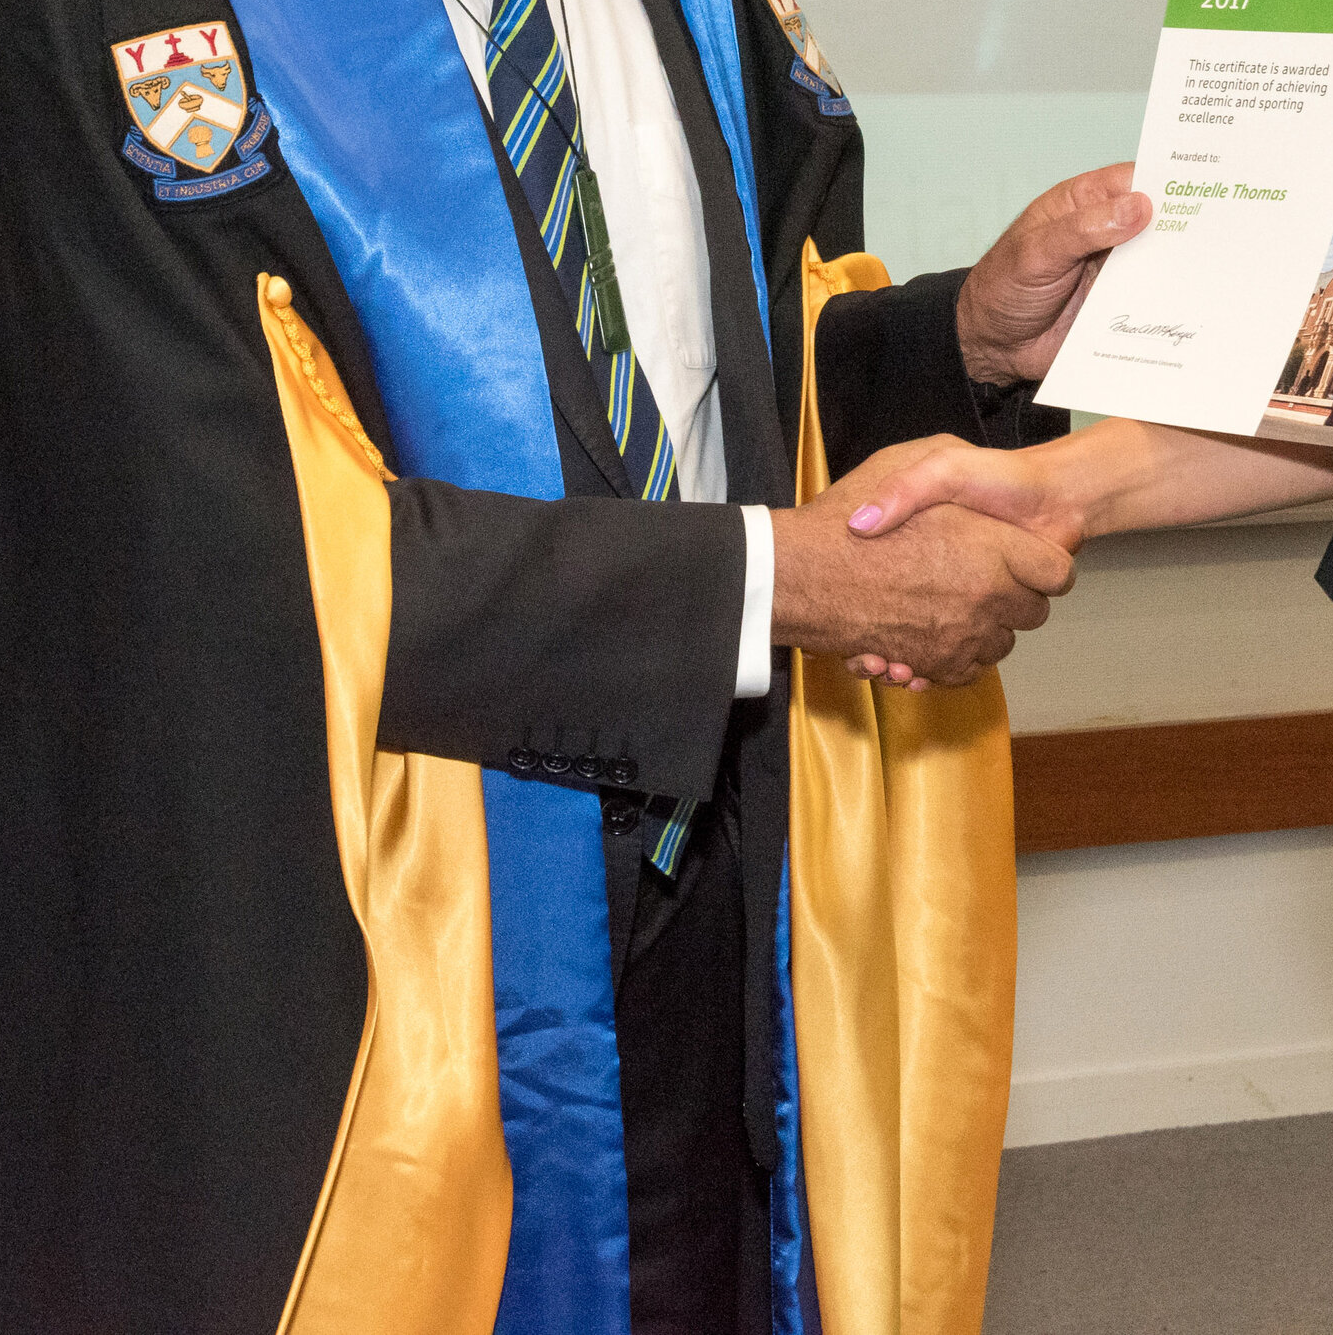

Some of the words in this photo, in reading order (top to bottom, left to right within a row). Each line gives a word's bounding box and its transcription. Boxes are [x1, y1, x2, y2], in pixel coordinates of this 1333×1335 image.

[1189, 59, 1211, 72] This
[1213, 61, 1267, 74] certificate
[1270, 62, 1279, 74] is
[1282, 64, 1330, 76] awarded
[1185, 76, 1195, 88] in
[1198, 77, 1259, 92] recognition
[1262, 80, 1274, 92] of
[1276, 81, 1328, 96] achieving
[1181, 95, 1233, 107] academic
[1235, 96, 1256, 108] and
[1258, 97, 1304, 113] sporting
[1178, 112, 1234, 125] excellence
[1170, 151, 1208, 162] Awarded
[1210, 154, 1221, 163] to:
[1164, 180, 1229, 198] Gabrielle
[1232, 184, 1288, 201] Thomas
[1160, 202, 1202, 216] Netball
[1155, 219, 1188, 232] BSRM
